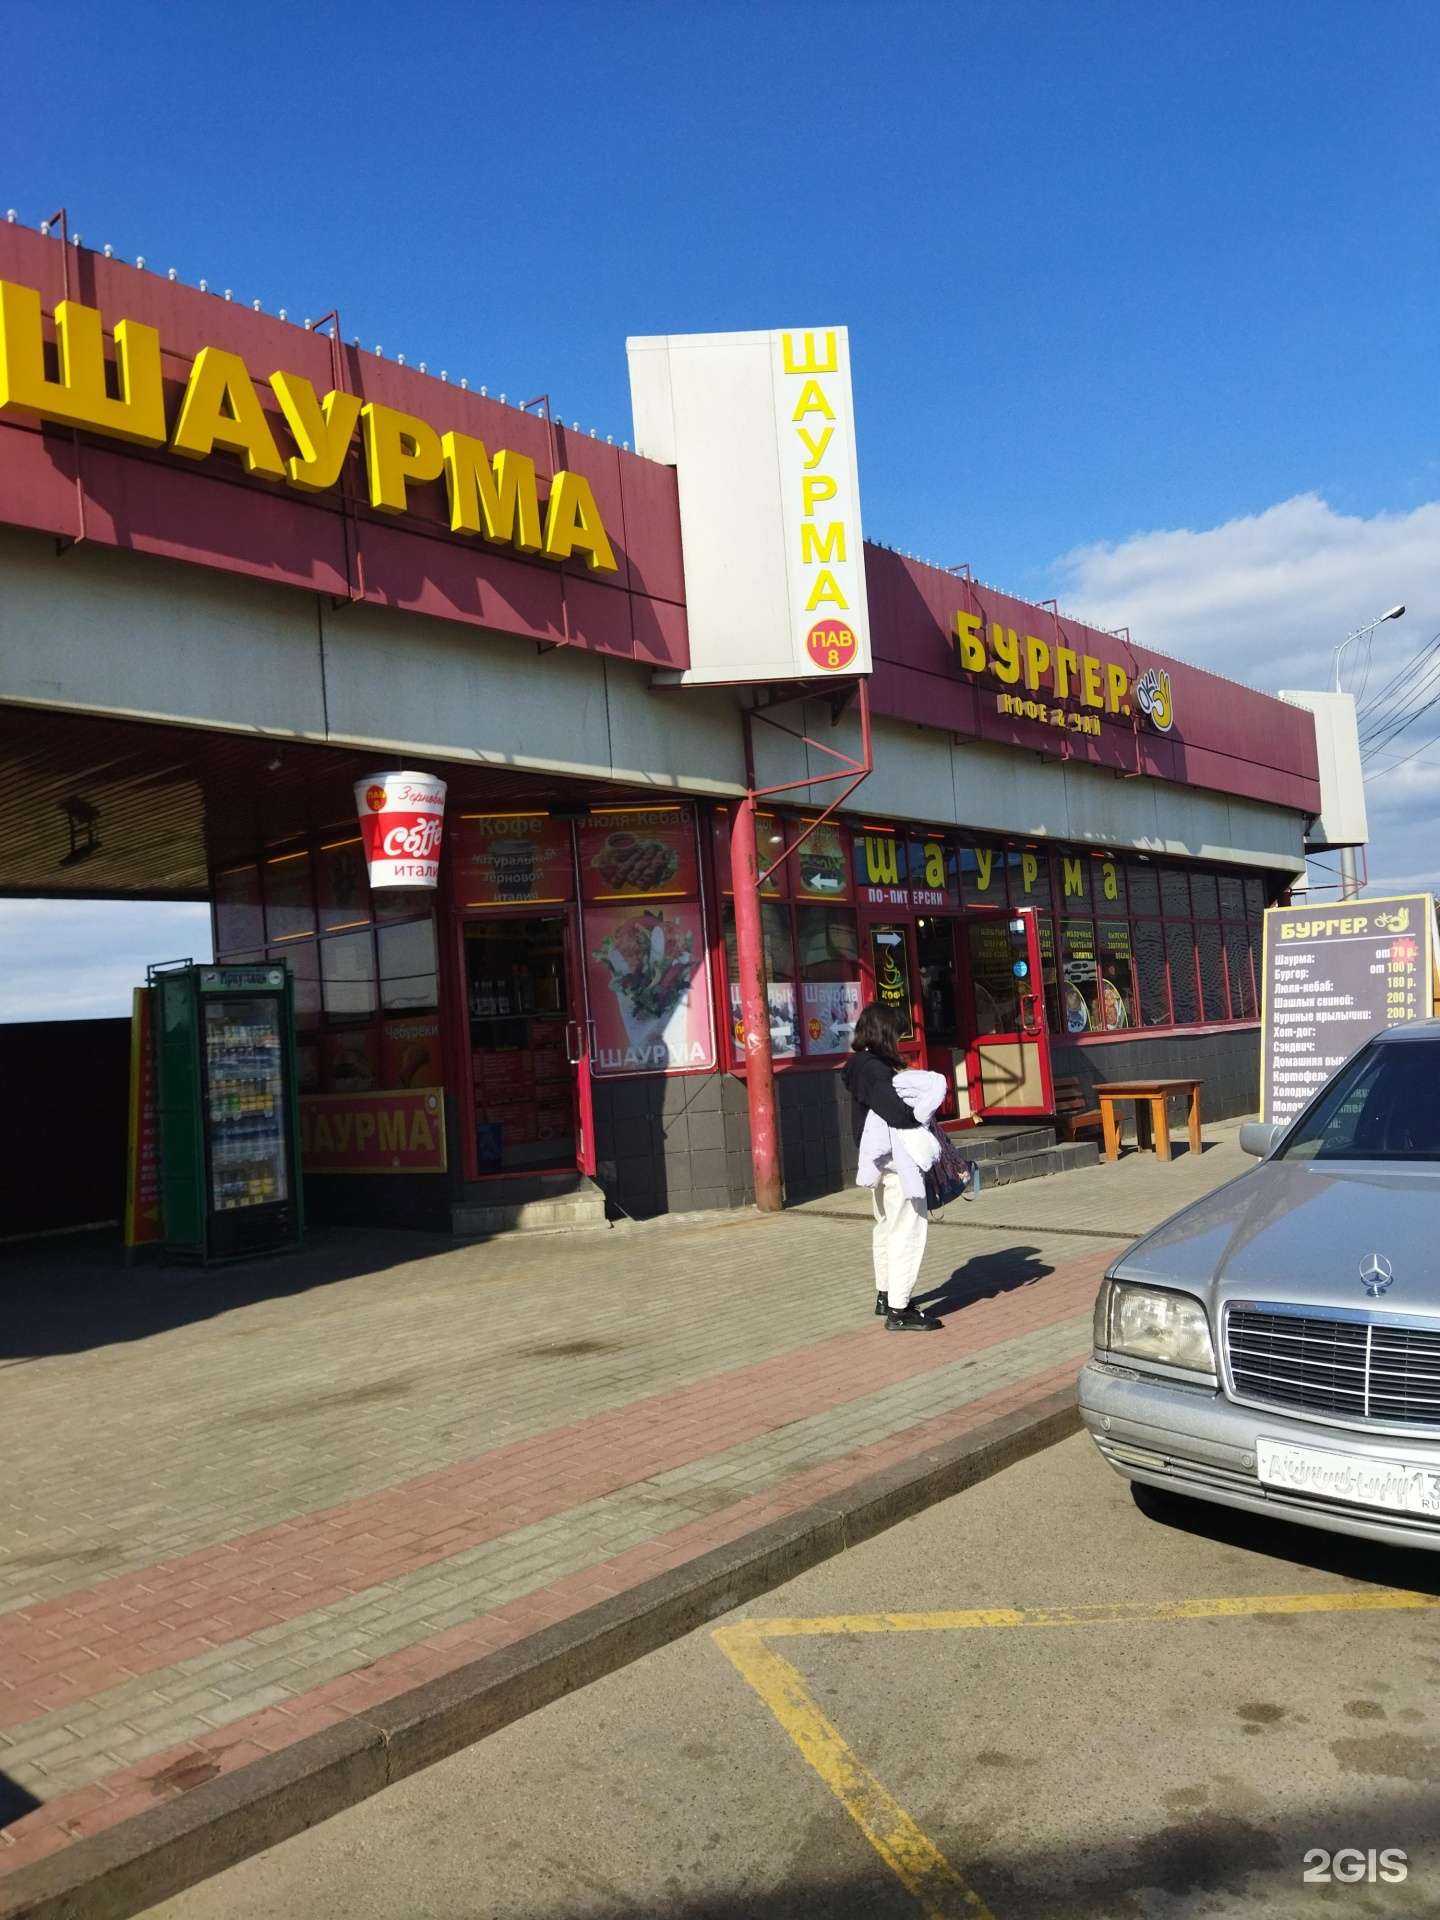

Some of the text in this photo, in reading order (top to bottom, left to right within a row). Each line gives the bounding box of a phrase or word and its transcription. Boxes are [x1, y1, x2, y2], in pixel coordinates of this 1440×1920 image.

[0, 279, 619, 574] ШАУРМА
[781, 331, 850, 612] ШАУРМА
[811, 630, 853, 649] ПАВ
[827, 650, 838, 667] 8
[478, 816, 544, 838] Кофе
[1274, 953, 1315, 967] Шаурма:
[1387, 962, 1405, 973] 100
[1274, 969, 1310, 982] Бургер:
[1274, 980, 1334, 994] Люля-кебаб:
[1274, 997, 1315, 1009] Шашлык
[1386, 992, 1405, 1004] 200
[1273, 1011, 1314, 1025] Куриные
[1386, 1008, 1405, 1019] 200
[1273, 1026, 1316, 1038] Хот-дог:
[600, 1041, 706, 1069] ШАУРМА
